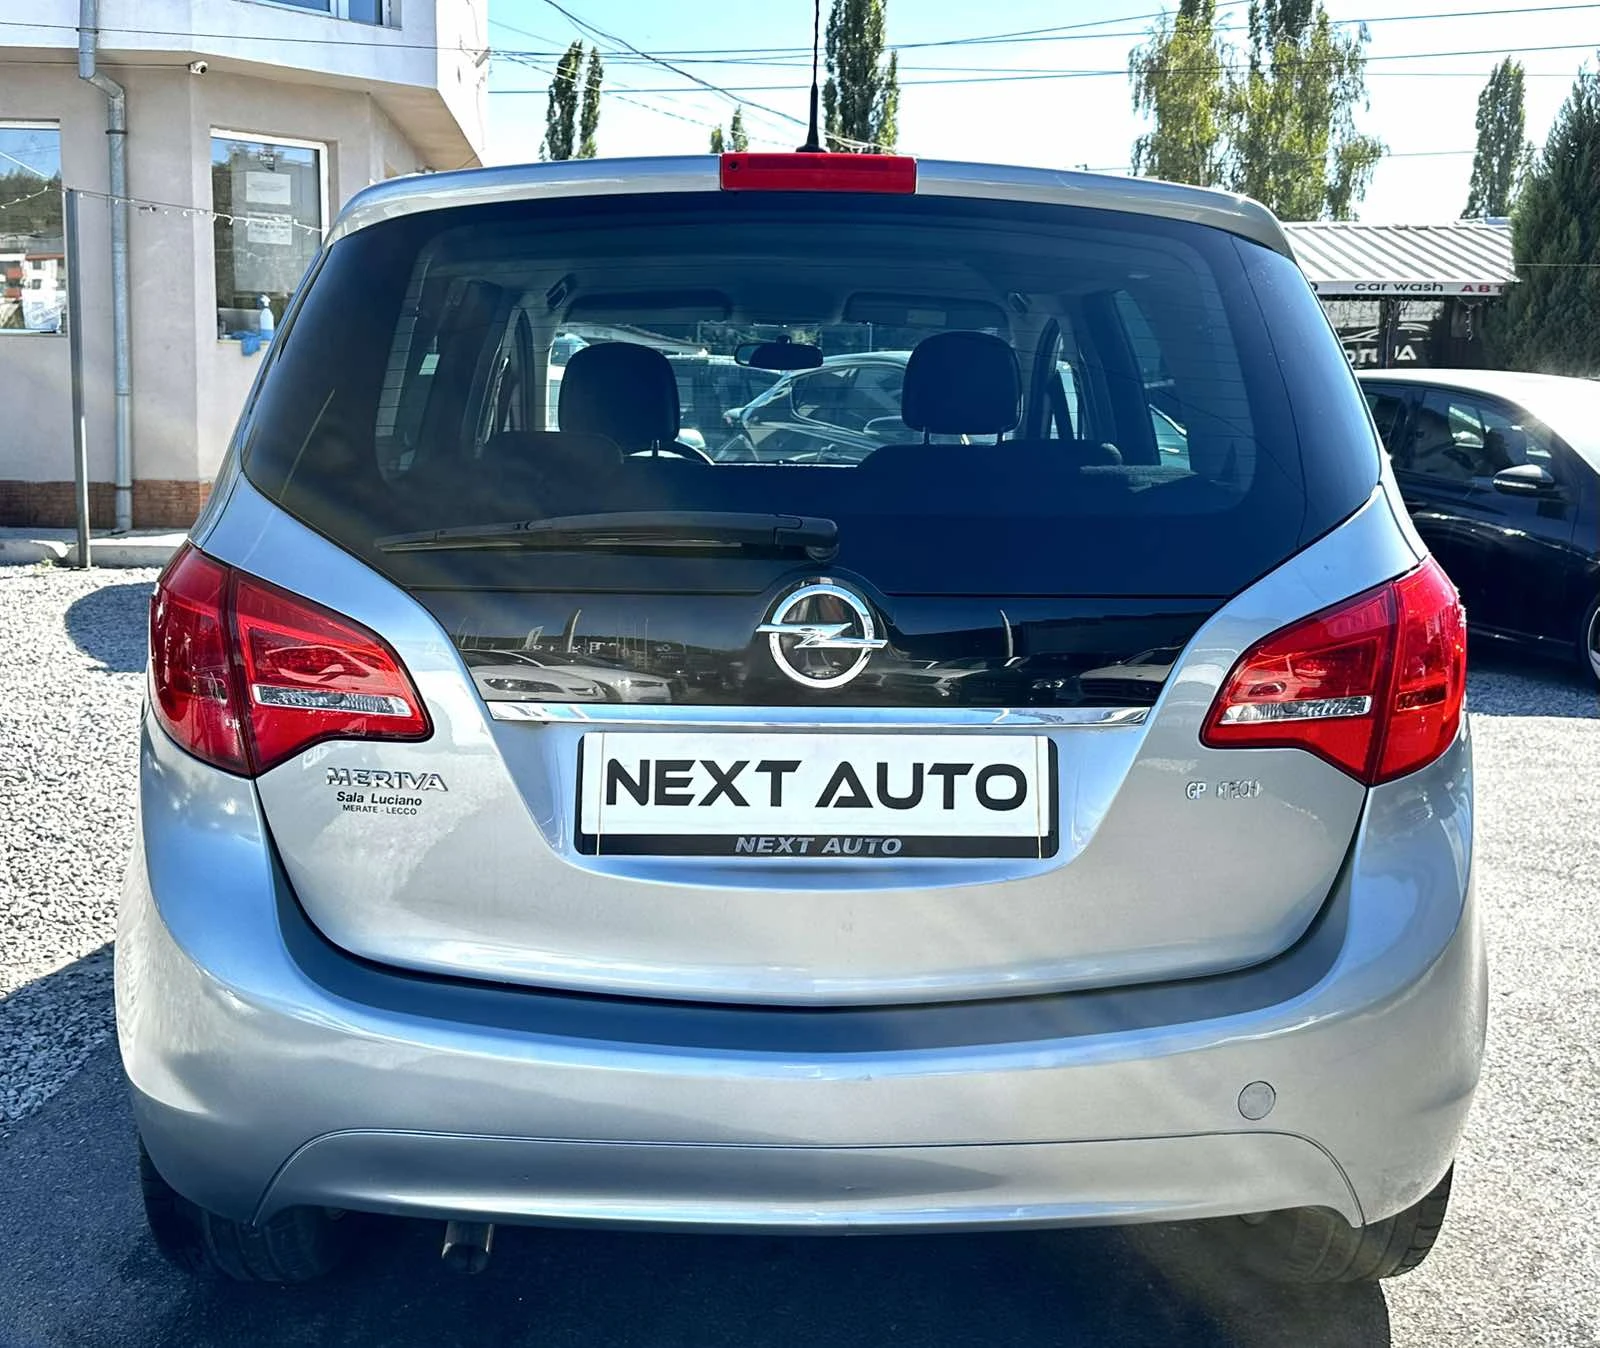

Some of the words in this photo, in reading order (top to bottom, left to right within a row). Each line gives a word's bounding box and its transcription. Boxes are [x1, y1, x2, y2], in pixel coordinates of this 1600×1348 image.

[1354, 282, 1387, 292] car
[1394, 281, 1444, 292] wash
[326, 767, 449, 792] MERIVA
[606, 757, 803, 808] NEXT
[814, 760, 1028, 811] AUTO
[336, 791, 364, 803] Sala
[371, 793, 423, 806] Luciano
[342, 804, 378, 814] MERATE
[386, 806, 418, 815] LECCO
[734, 836, 816, 854] NEXT
[821, 837, 902, 855] AUTO
